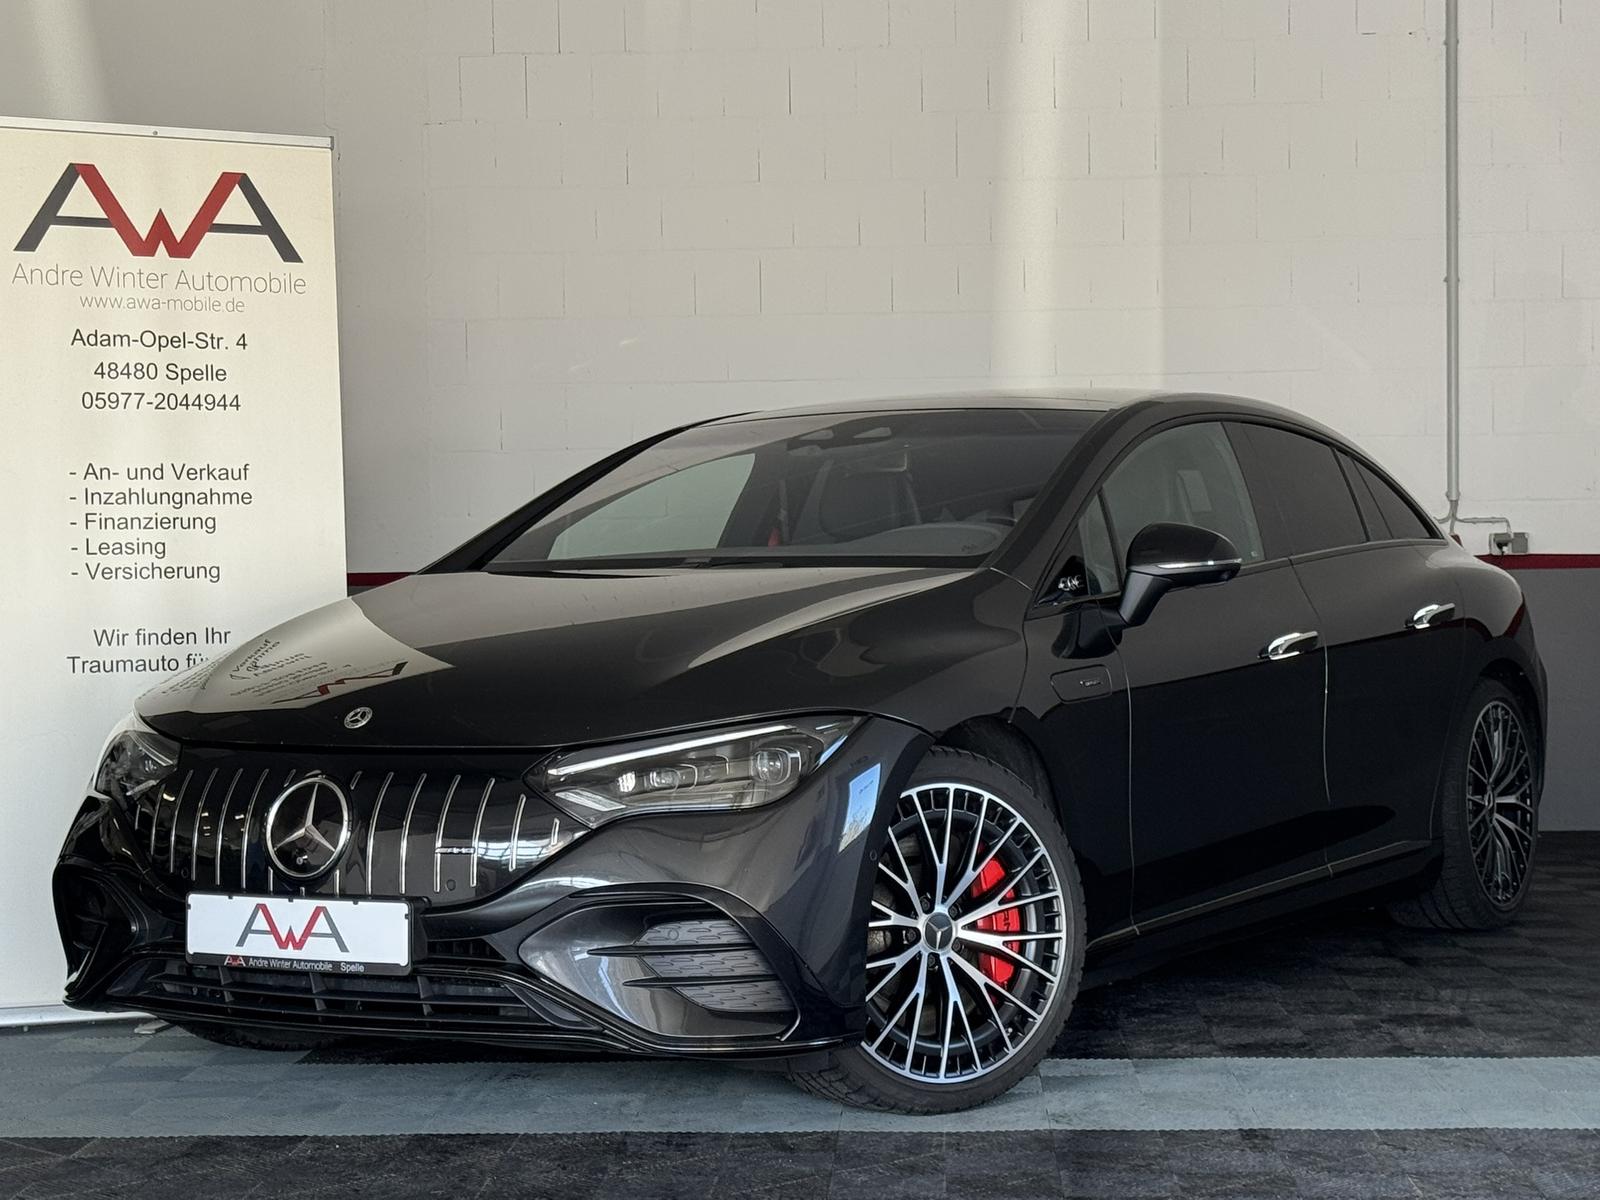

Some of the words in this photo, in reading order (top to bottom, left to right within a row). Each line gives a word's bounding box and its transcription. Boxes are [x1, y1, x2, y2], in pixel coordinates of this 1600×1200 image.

[12, 263, 83, 286] Andre
[90, 266, 168, 289] Winter
[175, 270, 306, 294] Automobile
[80, 296, 245, 312] www.awa-mobile.de
[71, 328, 228, 352] Adam-Opel-Str.
[236, 333, 248, 350] 4
[94, 361, 158, 380] 48480
[166, 363, 227, 385] Spelle
[82, 391, 241, 411] 05977-2044944
[83, 463, 119, 481] An-
[127, 463, 164, 481] und
[171, 463, 250, 481] Verkauf
[85, 488, 252, 510] Inzahlungnahme
[85, 512, 216, 534] Finanzierung
[86, 537, 166, 559] Leasing
[85, 562, 220, 583] Versicherung
[93, 629, 129, 647] Wir
[135, 628, 197, 646] finden
[205, 627, 231, 644] Ihr
[66, 655, 179, 674] Traumauto
[248, 957, 268, 968] Andre
[269, 959, 291, 969] Winter
[292, 960, 333, 972] Automobile
[340, 962, 365, 973] Spelle
